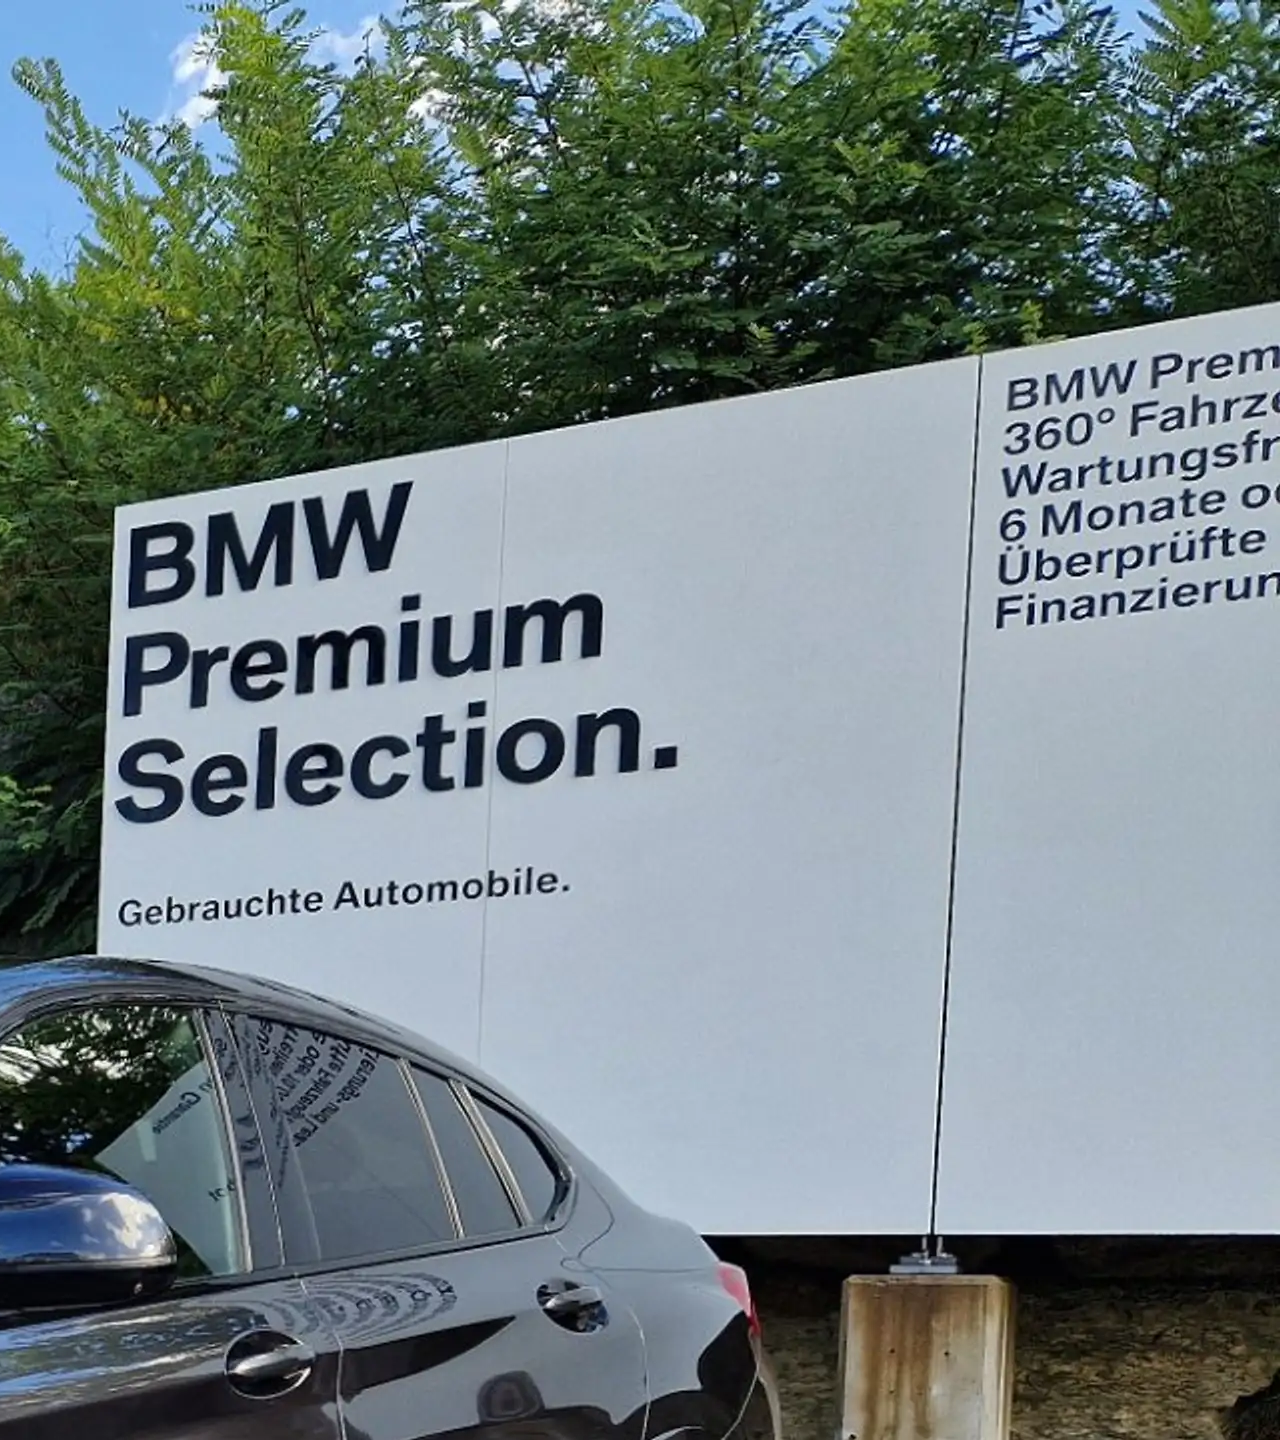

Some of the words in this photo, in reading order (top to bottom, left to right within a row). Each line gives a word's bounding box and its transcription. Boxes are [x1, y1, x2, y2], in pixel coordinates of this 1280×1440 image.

[1007, 359, 1138, 411] BMW
[1150, 344, 1280, 389] Prem
[1003, 407, 1116, 455] 360°
[1000, 508, 1027, 542] 6
[1041, 488, 1226, 537] Monate
[1241, 483, 1280, 509] o
[127, 481, 414, 609] BMW
[998, 526, 1267, 586] Überprüfte
[122, 591, 604, 717] Premium
[114, 700, 678, 824] Selection.
[118, 886, 324, 927] Gebrauchte
[333, 867, 570, 911] Automobile.
